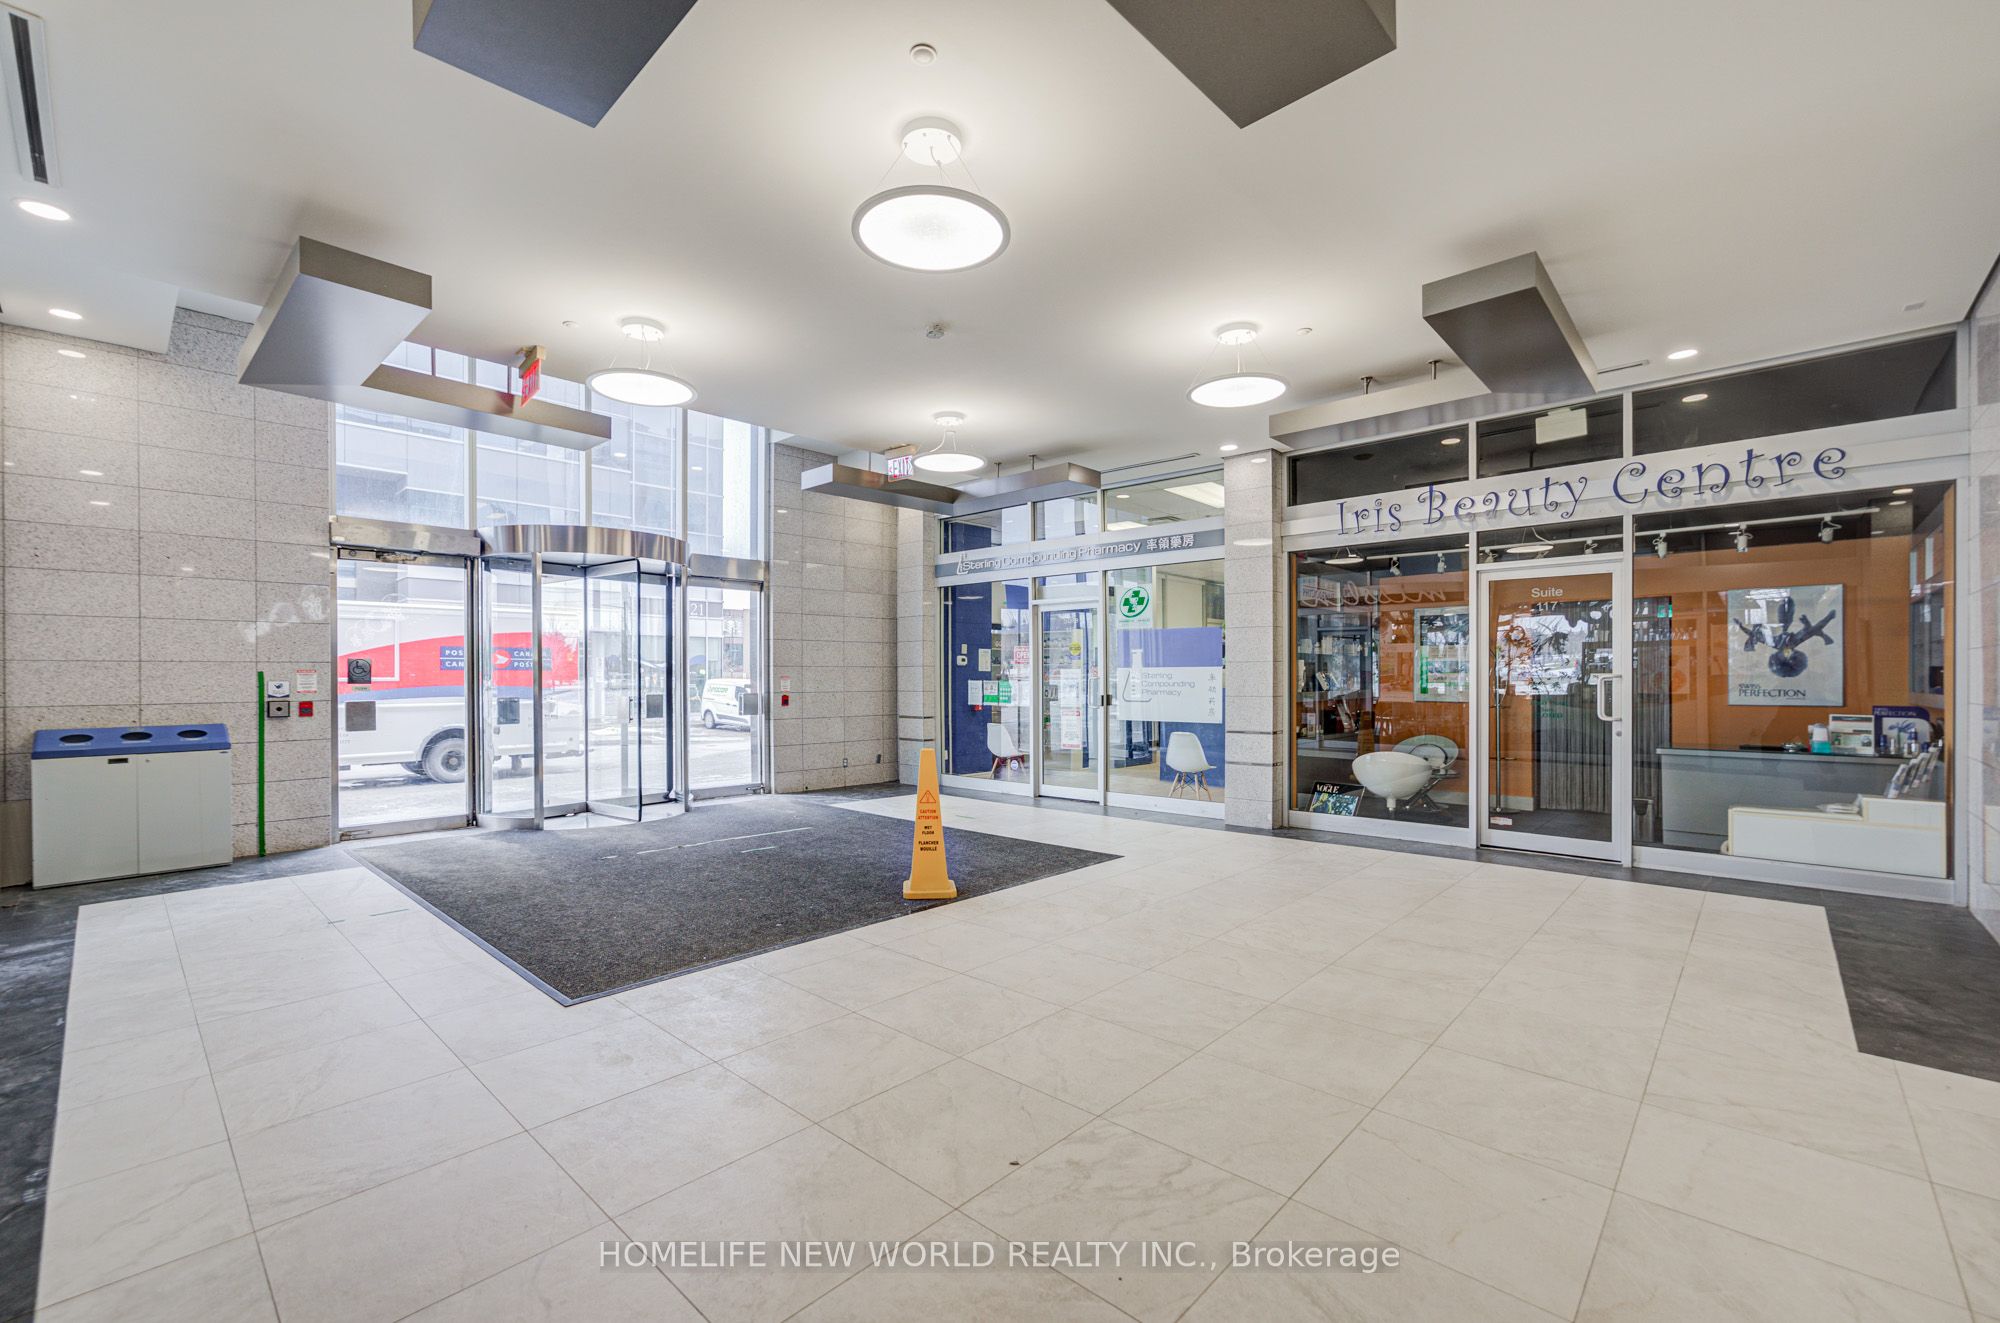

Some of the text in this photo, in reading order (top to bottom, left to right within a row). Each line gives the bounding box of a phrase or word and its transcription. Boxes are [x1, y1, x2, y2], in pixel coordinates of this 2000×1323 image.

[893, 456, 910, 477] EXIT
[1337, 447, 1847, 535] Iris Beauty Centre
[963, 541, 1141, 571] Sterling Compounding Pharmacy
[1531, 587, 1563, 598] Suite
[690, 603, 704, 616] 21
[1537, 602, 1558, 611] 117
[1142, 672, 1172, 680] Sterling
[1142, 680, 1195, 689] Compounding
[1142, 688, 1182, 696] Pharmacy
[1738, 689, 1806, 698] PERFECTION
[1316, 784, 1340, 794] VOGUE
